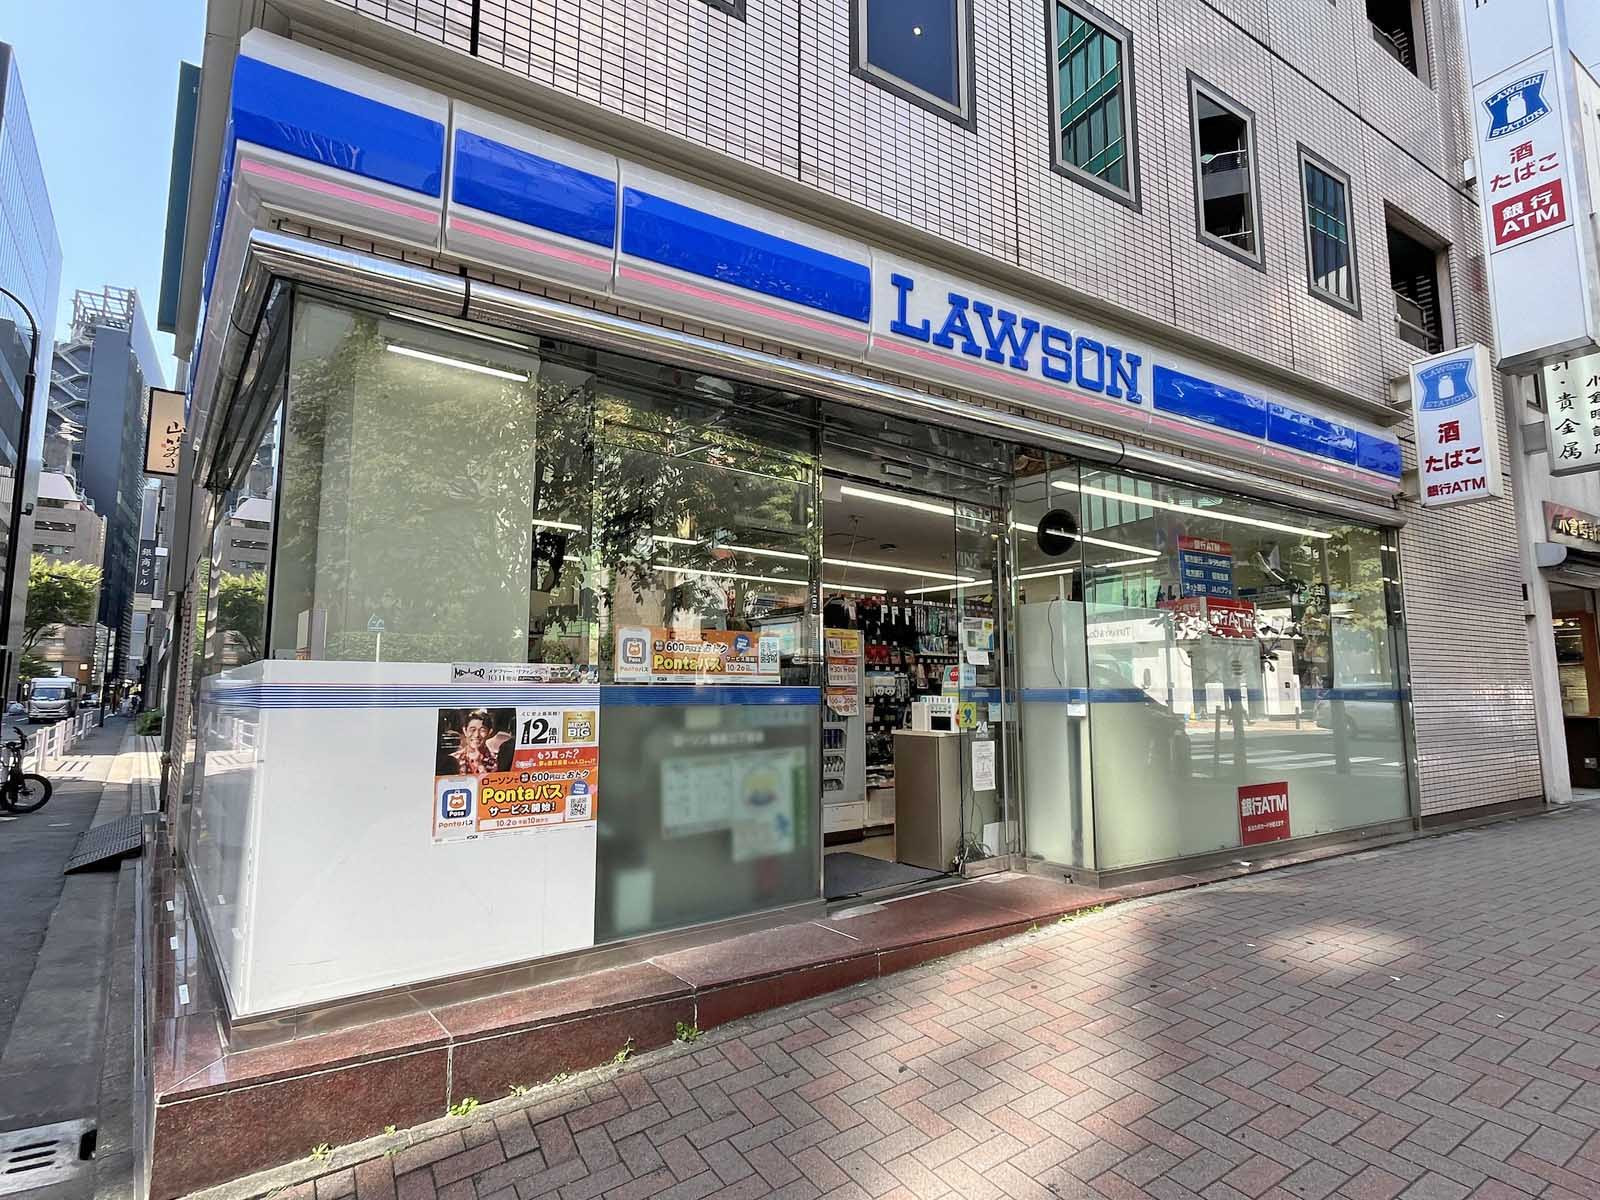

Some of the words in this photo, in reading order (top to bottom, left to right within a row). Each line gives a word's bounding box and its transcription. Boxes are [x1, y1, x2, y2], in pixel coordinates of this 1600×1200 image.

[1487, 74, 1543, 107] LAWSON
[1491, 107, 1545, 137] STATION
[1510, 140, 1534, 164] 酒
[1490, 153, 1559, 192] たばこ
[1502, 190, 1553, 219] 銀行
[1501, 203, 1559, 237] ATM
[891, 272, 1142, 404] LAWSON
[1422, 362, 1468, 380] LAWSON
[1424, 392, 1470, 407] STATION
[1438, 420, 1460, 444] 酒
[1425, 447, 1483, 473] たばこ
[1427, 477, 1486, 498] 銀行ATM
[653, 654, 722, 672] Pontaパス
[567, 728, 591, 738] BIG
[975, 720, 988, 733] 24
[481, 784, 563, 804] Pontaパス
[1241, 794, 1288, 817] 銀行ATM
[438, 819, 473, 829] Pontaパス
